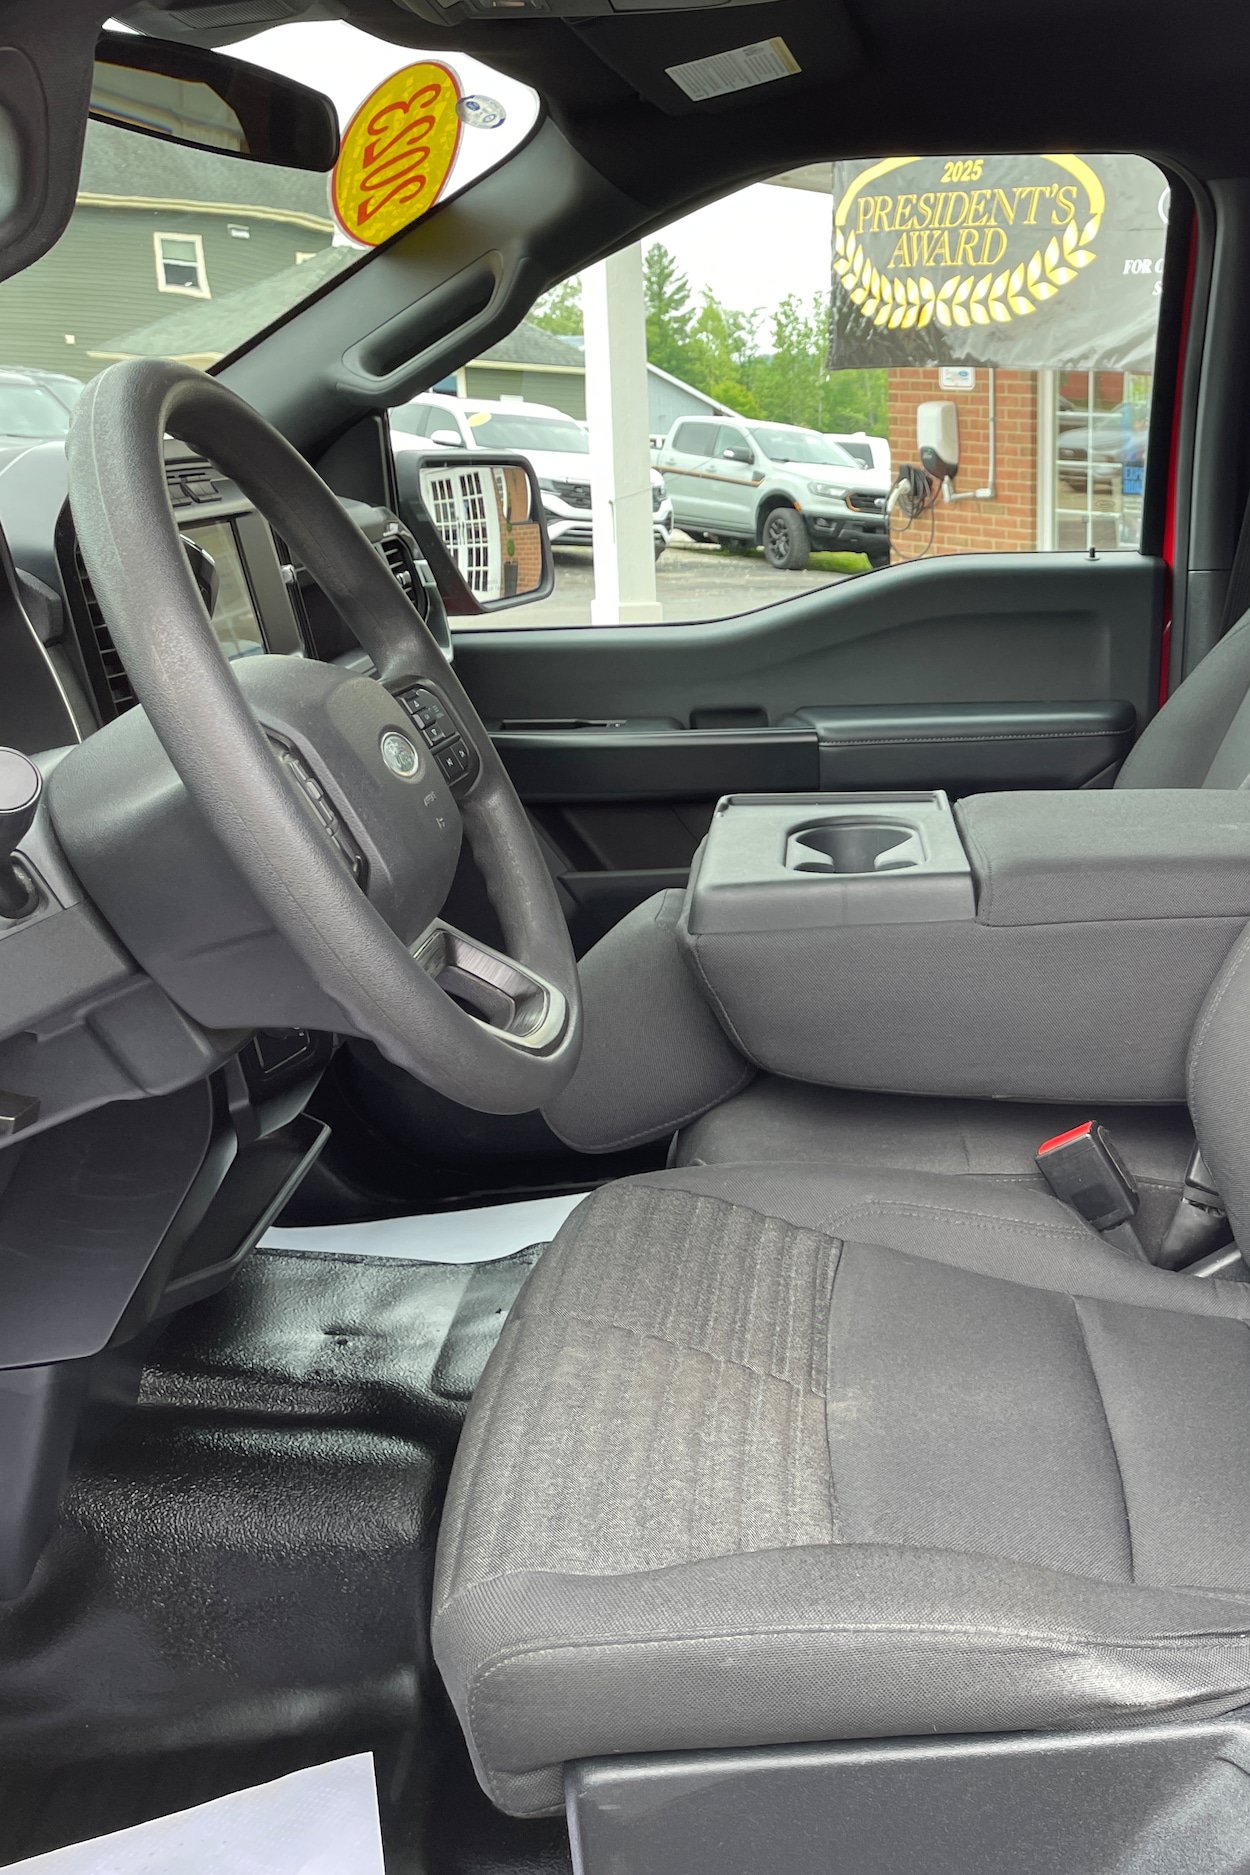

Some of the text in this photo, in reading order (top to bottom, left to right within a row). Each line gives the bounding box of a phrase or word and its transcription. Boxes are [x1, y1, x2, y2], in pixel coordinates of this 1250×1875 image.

[940, 158, 984, 184] 2025
[855, 182, 1078, 234] PRESIDENT'S
[888, 227, 1008, 269] AWARD
[1122, 258, 1153, 275] FOR
